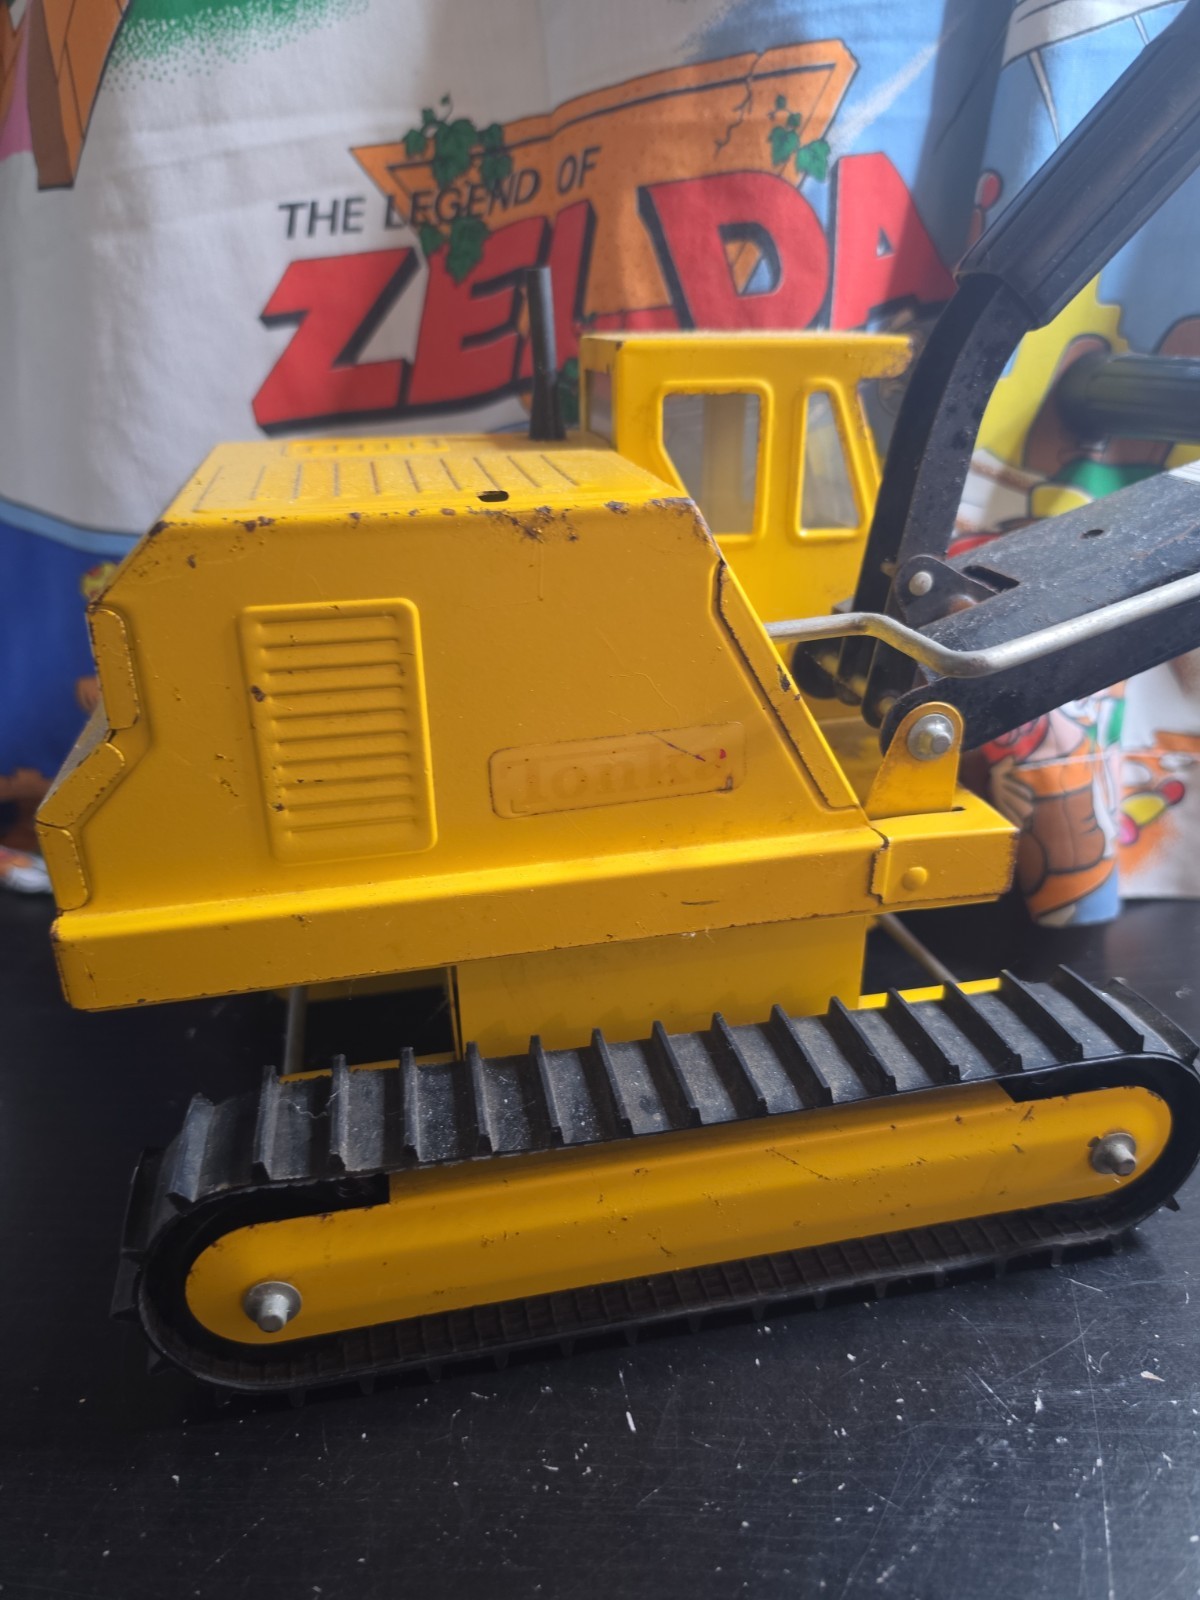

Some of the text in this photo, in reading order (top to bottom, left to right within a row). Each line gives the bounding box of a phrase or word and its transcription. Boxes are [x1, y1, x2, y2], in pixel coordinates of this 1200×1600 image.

[278, 146, 601, 239] THE LEGEND OF
[252, 152, 957, 434] ZELDA
